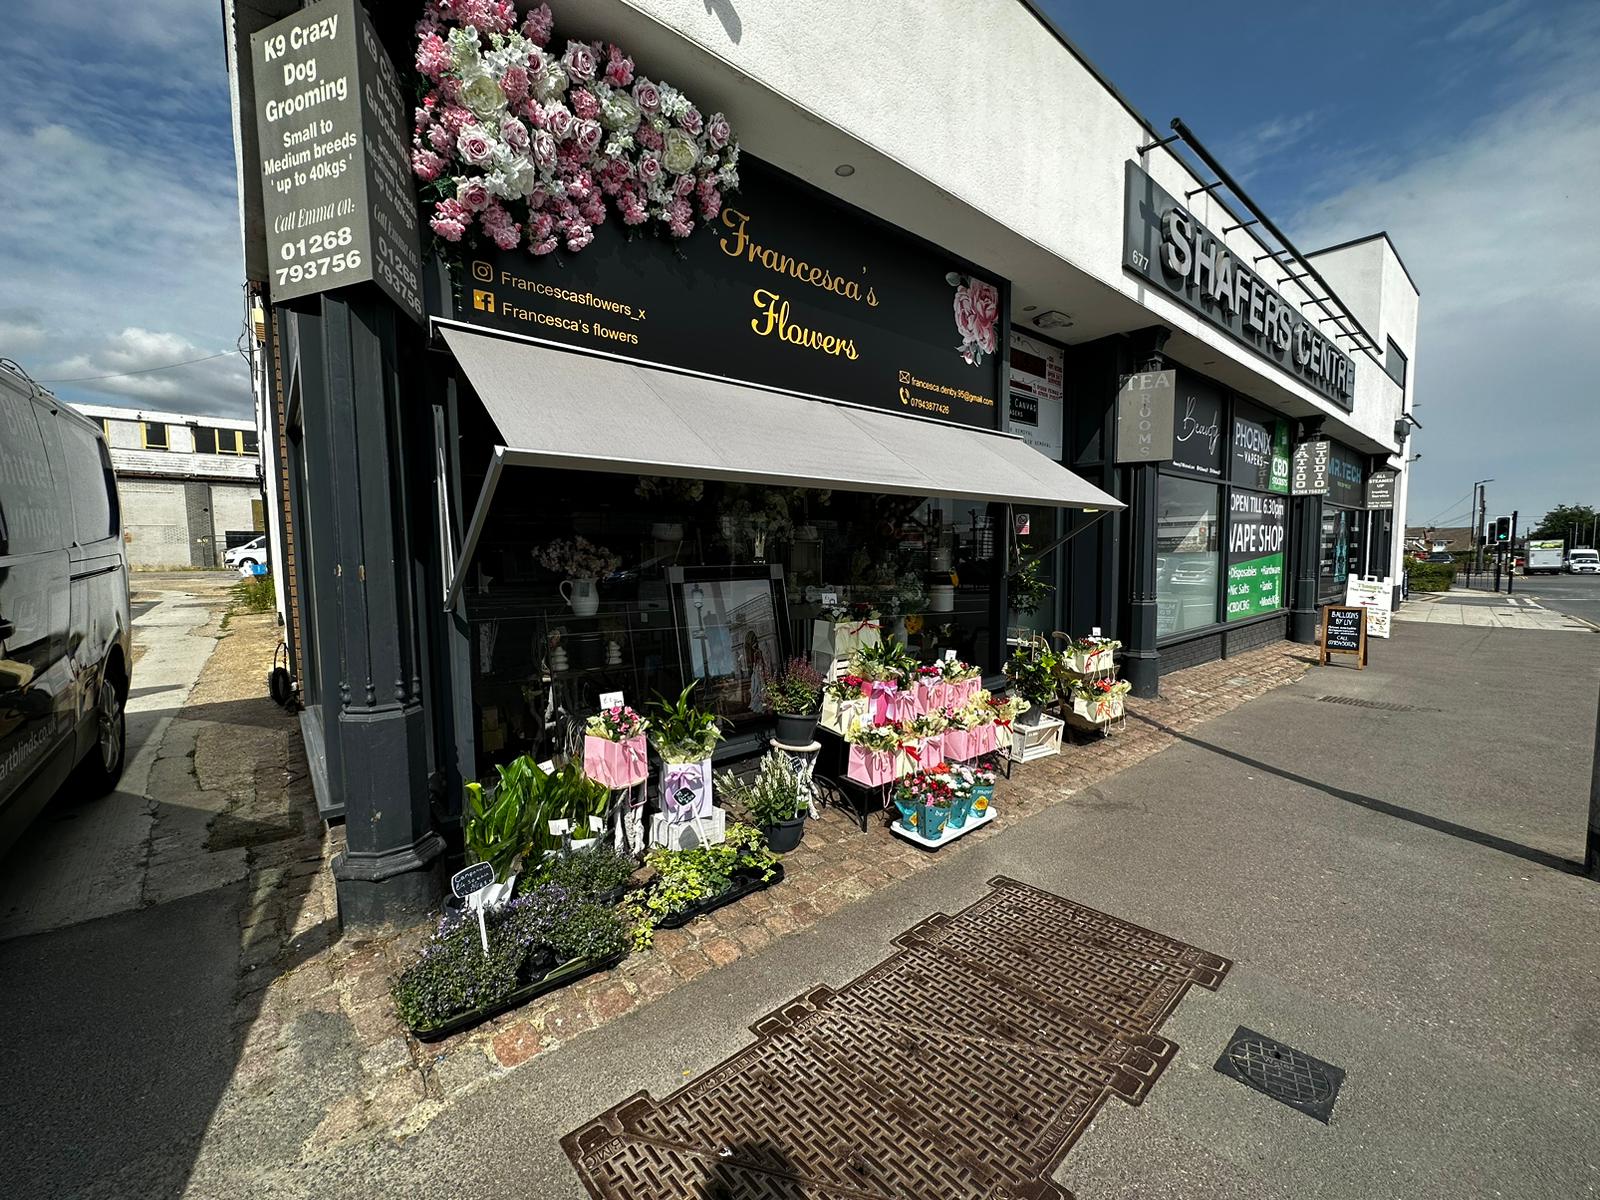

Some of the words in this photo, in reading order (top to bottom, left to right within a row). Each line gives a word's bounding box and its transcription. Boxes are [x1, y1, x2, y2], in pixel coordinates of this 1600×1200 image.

[264, 34, 286, 62] K9
[290, 13, 338, 50] Crazy
[363, 22, 378, 63] K9
[283, 58, 317, 86] Dog
[265, 76, 348, 122] Grooming
[376, 74, 396, 127] Dog
[264, 151, 312, 176] Medium
[313, 131, 358, 159] breeds
[283, 121, 318, 148] Small
[320, 119, 334, 136] to
[276, 175, 292, 195] up
[295, 171, 307, 186] to
[309, 158, 347, 182] 40kgs
[274, 210, 296, 234] Call
[298, 202, 335, 229] Emma
[337, 197, 356, 218] on:
[281, 226, 353, 261] 01268
[379, 235, 418, 290] 01268
[720, 207, 879, 307] Francesca's
[1132, 249, 1150, 271] 677
[275, 249, 362, 286] 793756
[376, 253, 422, 314] 793756
[501, 271, 646, 322] Francescasflowers_x
[1160, 207, 1292, 352] SHAFERS
[1292, 321, 1354, 398] CENTRE
[502, 302, 590, 335] Francesca's
[593, 323, 639, 345] flowers
[751, 288, 860, 361] Flowers
[1124, 372, 1170, 391] TEA
[1139, 394, 1152, 457] ROOMS
[1177, 396, 1220, 455] Beauty
[1235, 423, 1272, 456] PHOENIX
[1244, 450, 1264, 467] VAPERS
[1272, 457, 1288, 477] CBD
[1295, 443, 1310, 489] TATTOO
[1314, 441, 1328, 488] STUDIO
[1231, 493, 1249, 512] OPEN
[1250, 496, 1262, 513] TILL
[1263, 498, 1284, 519] 6.30pm
[1230, 523, 1257, 553] VAPE
[1258, 524, 1284, 553] SHOP
